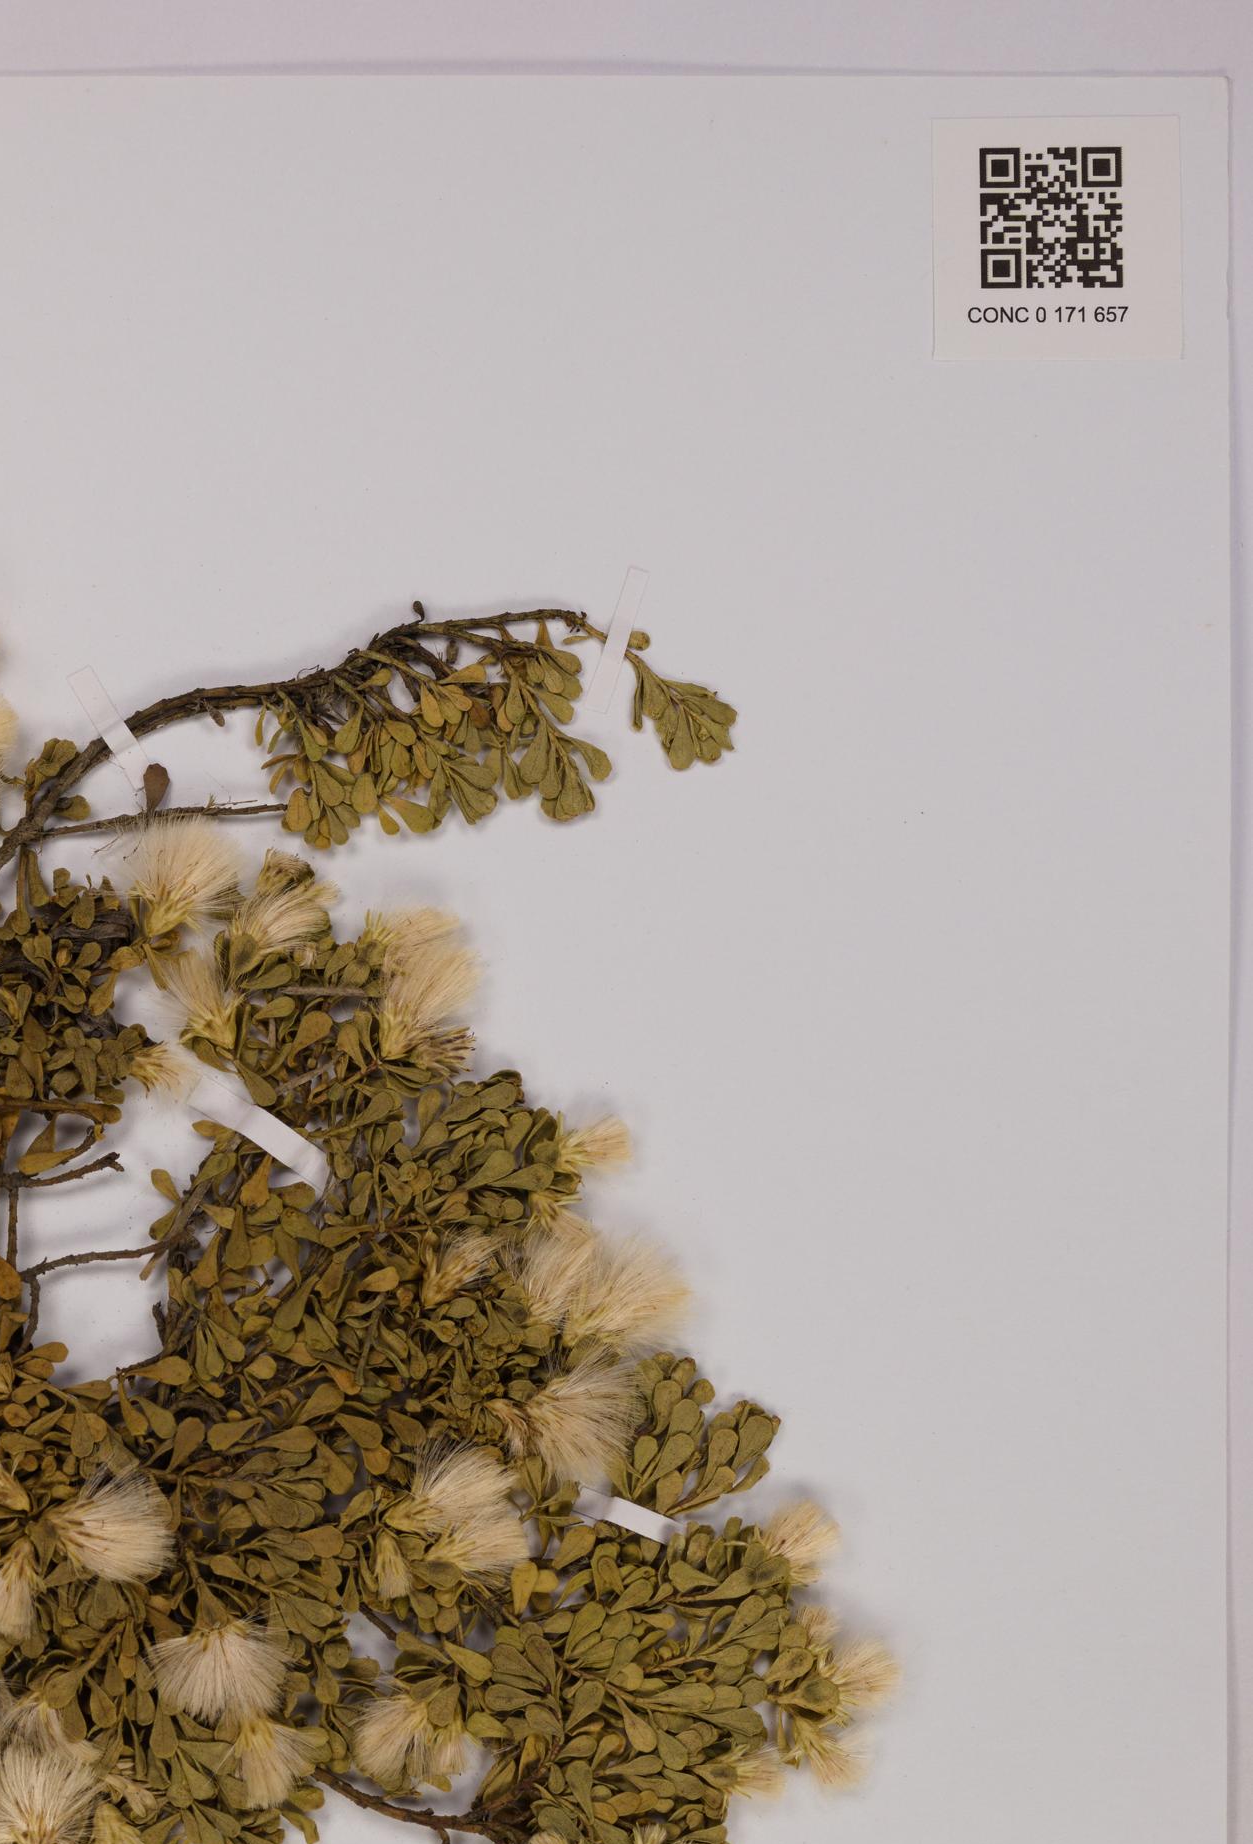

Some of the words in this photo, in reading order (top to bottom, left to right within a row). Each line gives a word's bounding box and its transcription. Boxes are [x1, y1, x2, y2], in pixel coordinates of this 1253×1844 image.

[967, 306, 1030, 324] CONC
[1035, 306, 1047, 324] 0
[1054, 305, 1086, 323] 171
[1093, 305, 1129, 323] 657
